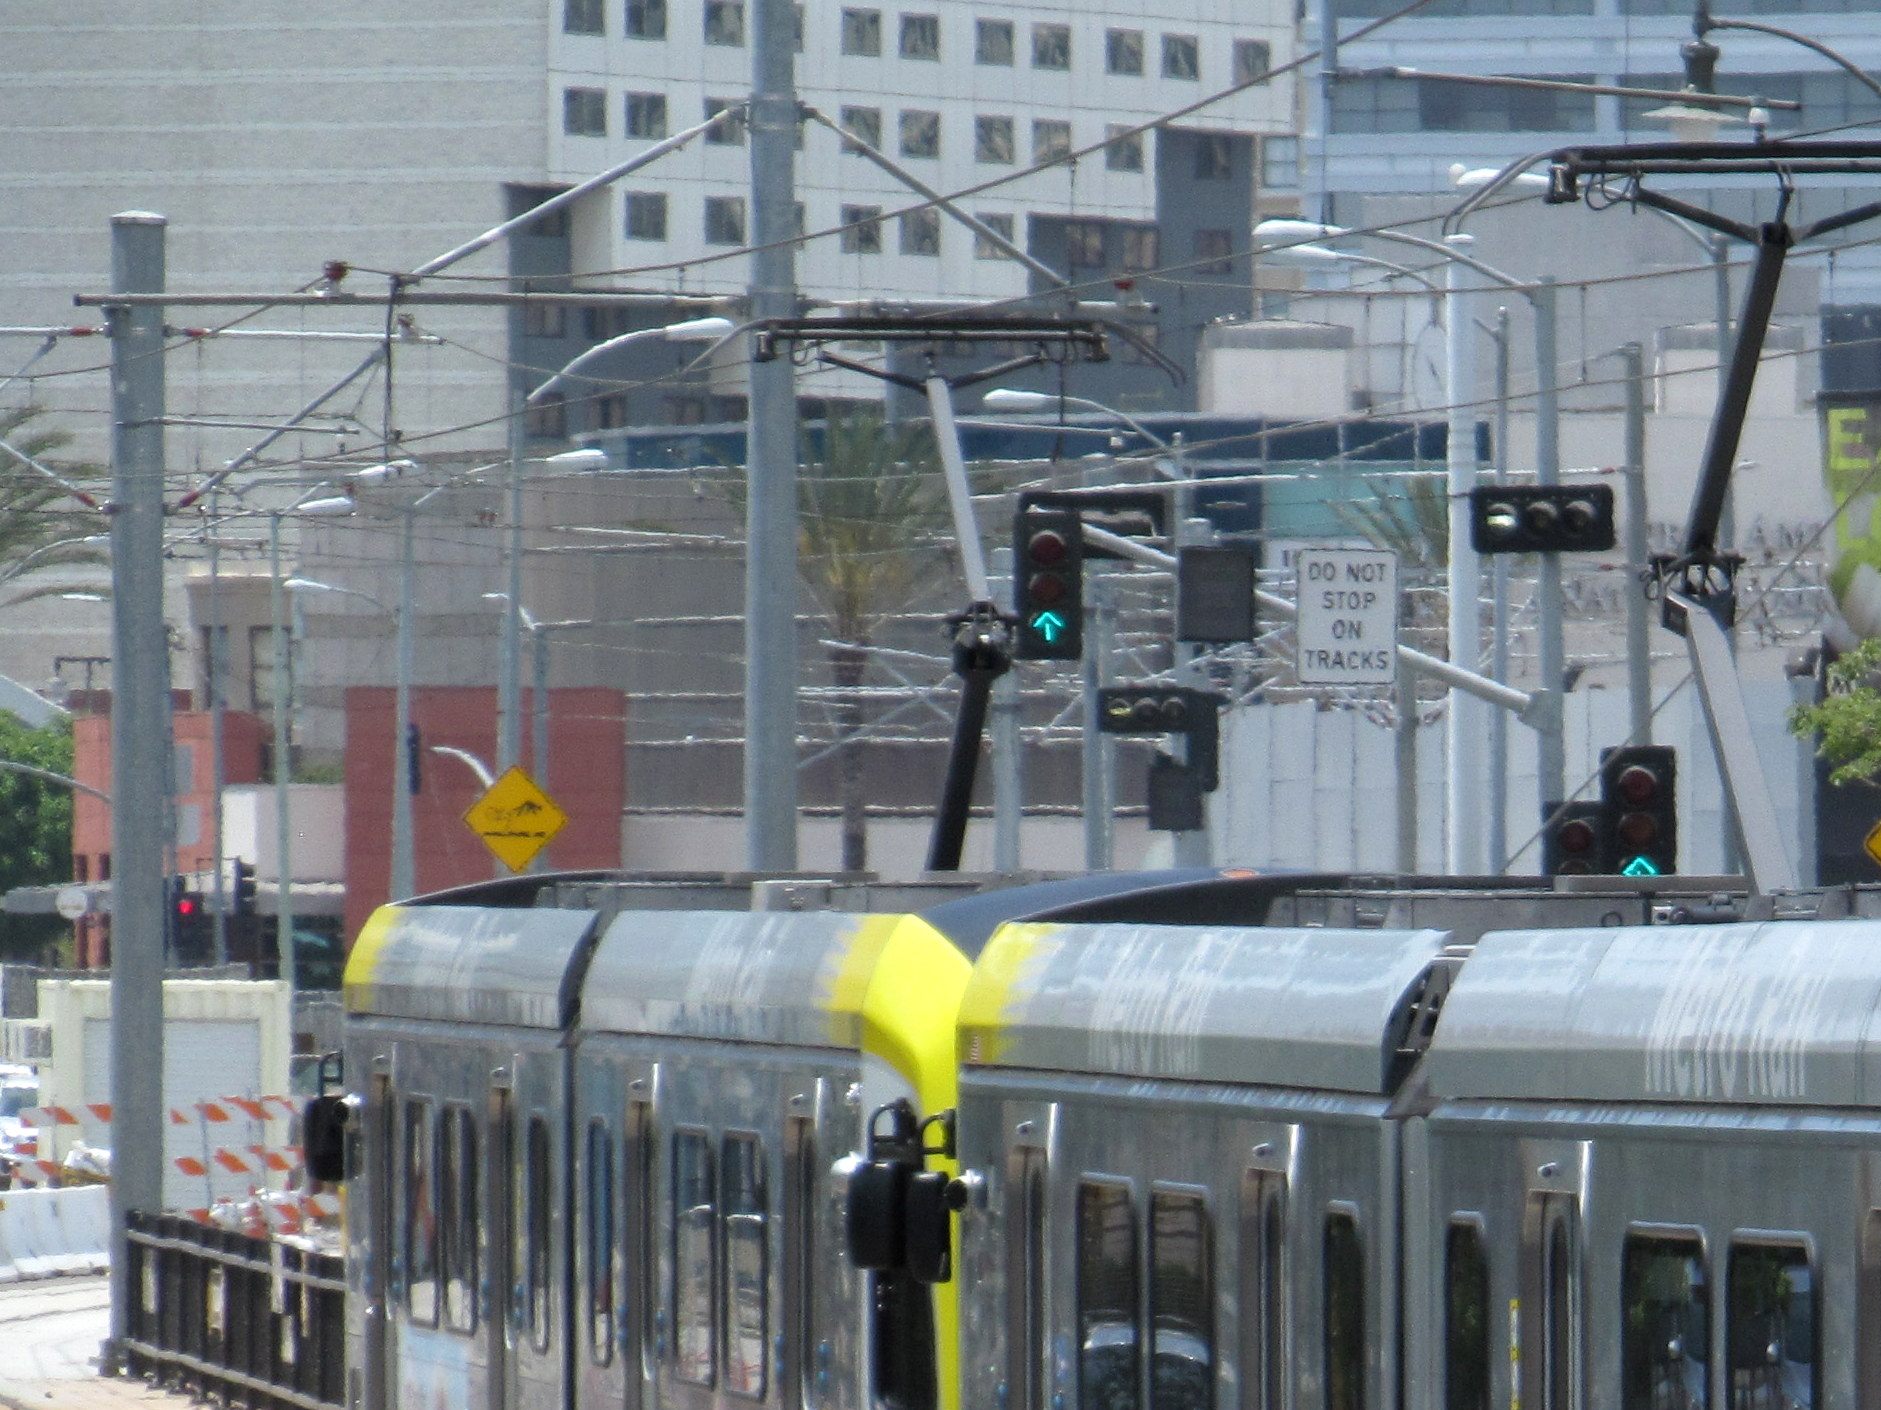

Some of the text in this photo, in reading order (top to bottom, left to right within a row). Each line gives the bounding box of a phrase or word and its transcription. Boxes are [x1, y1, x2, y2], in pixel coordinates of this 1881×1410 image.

[1308, 561, 1387, 583] DO NOT
[1322, 590, 1377, 610] STOP
[1331, 619, 1362, 640] ON
[1304, 649, 1389, 671] TRACKS
